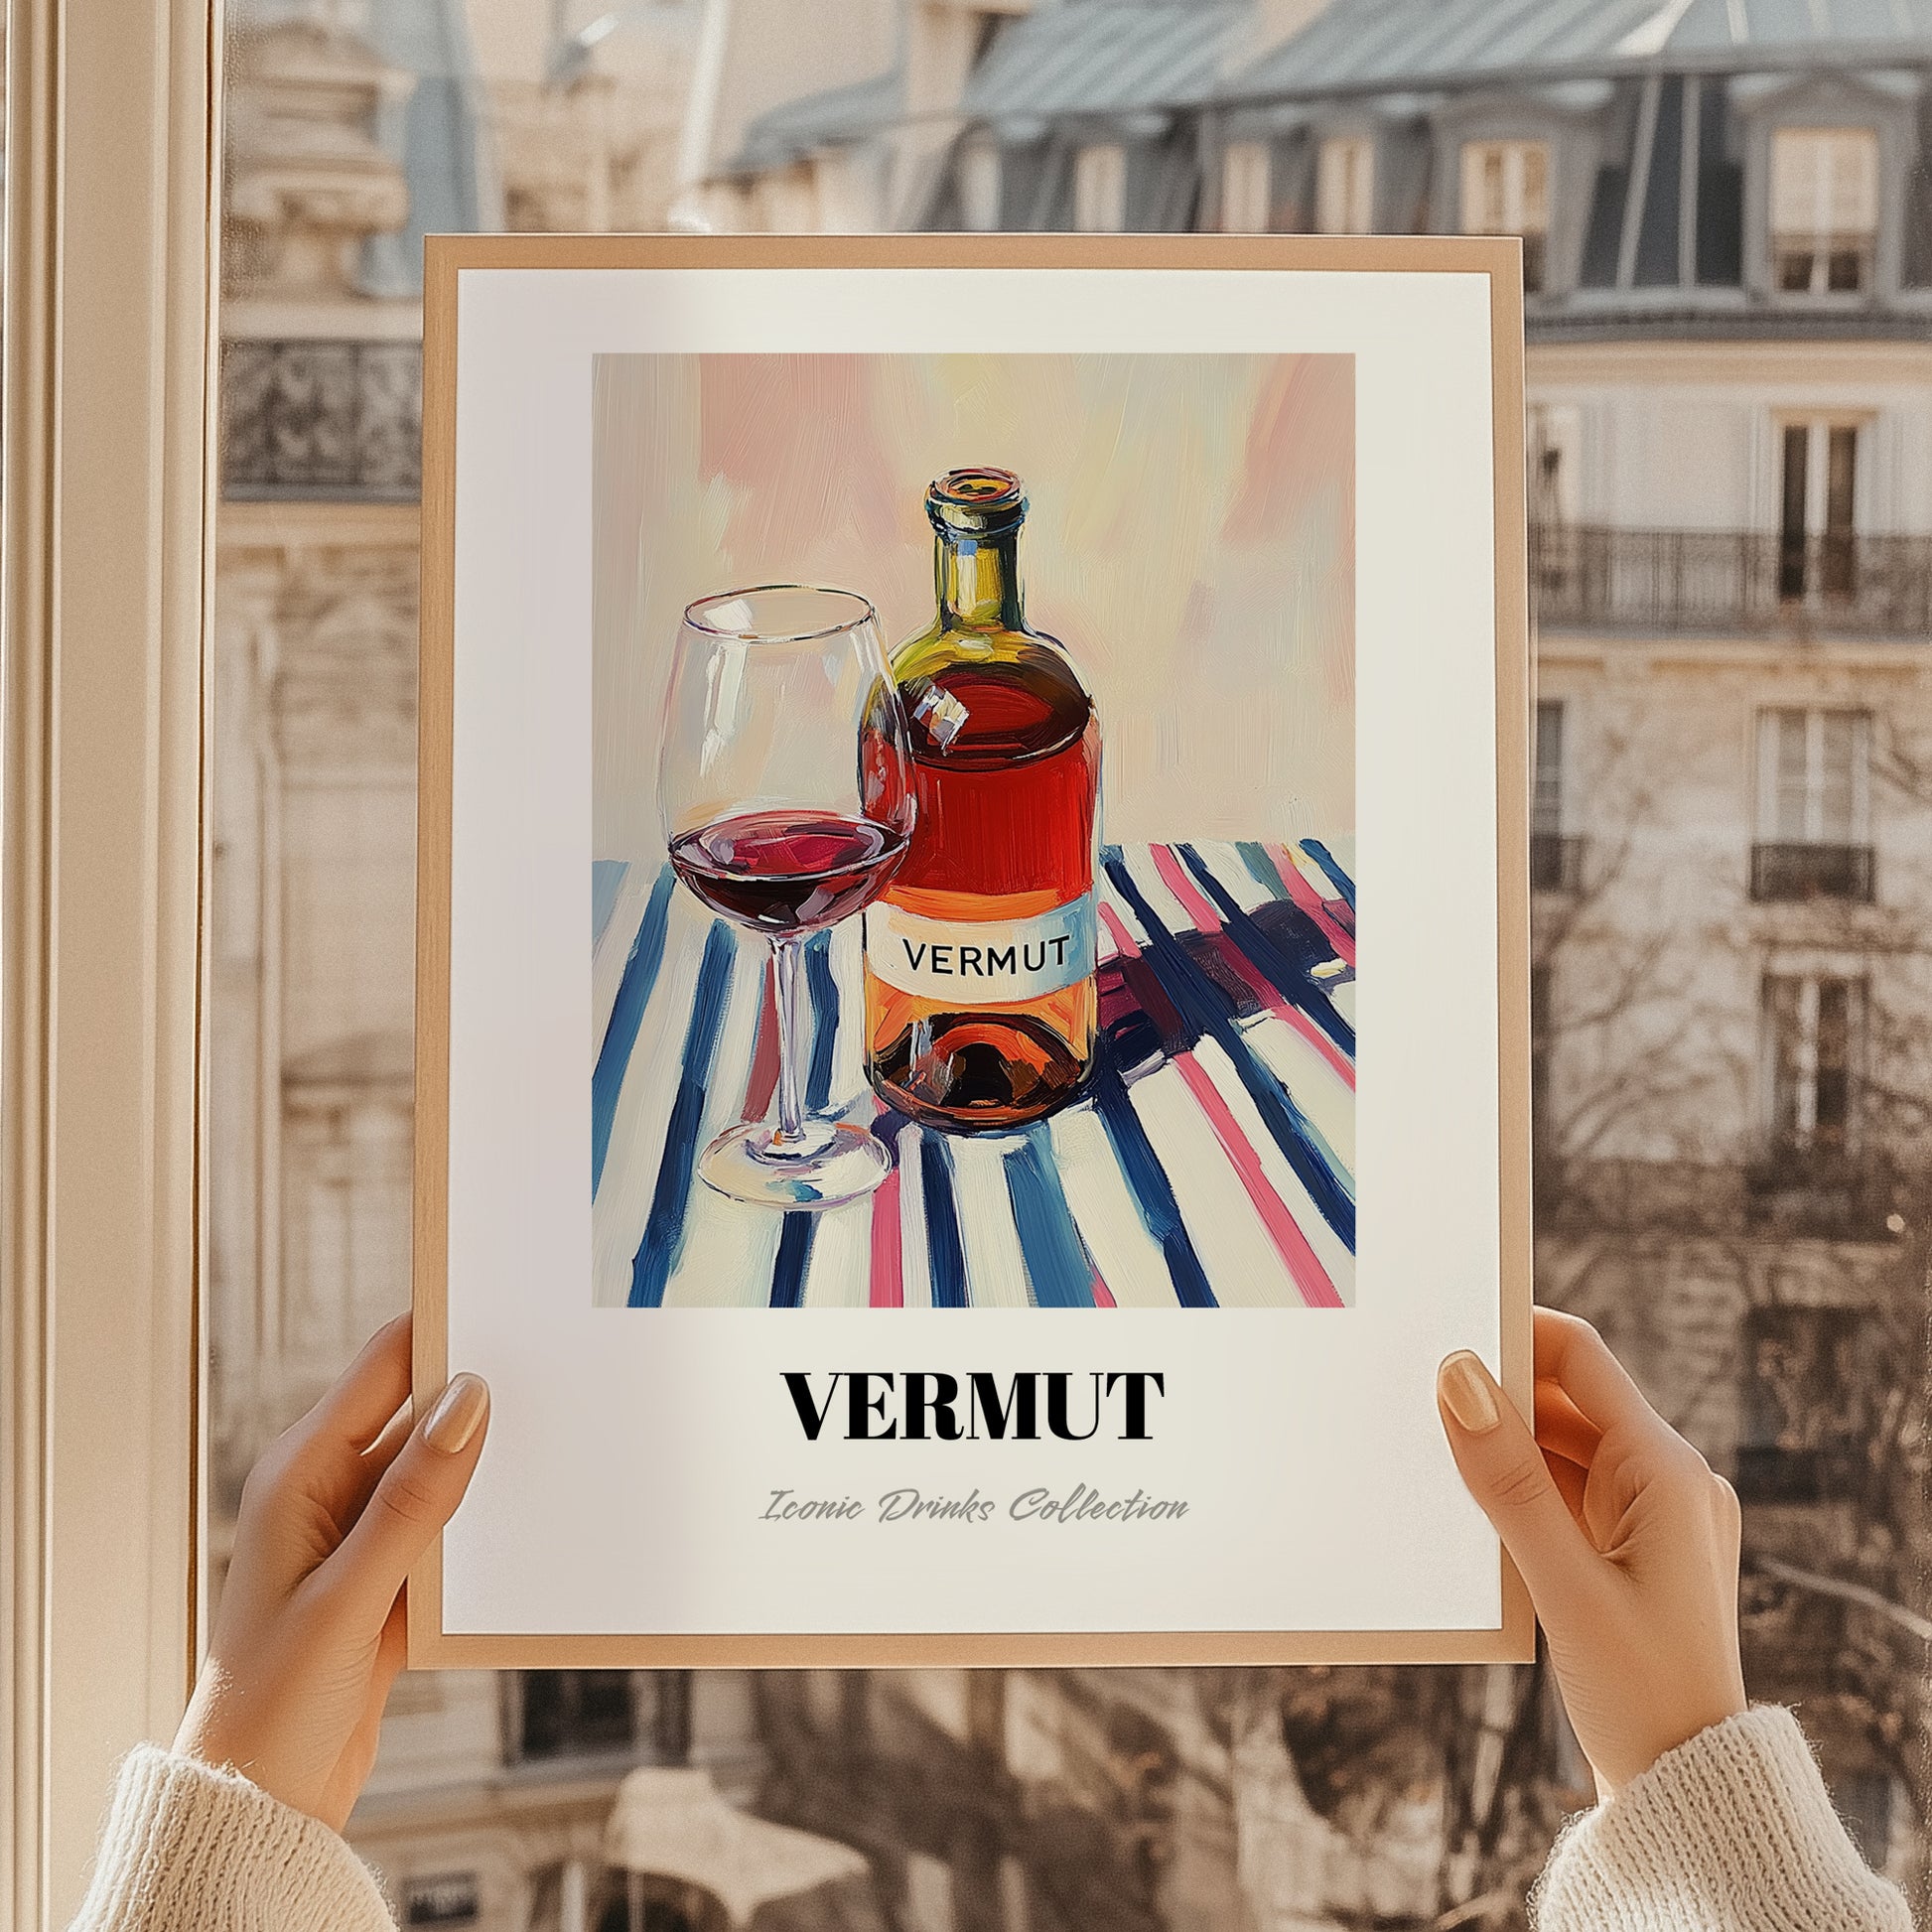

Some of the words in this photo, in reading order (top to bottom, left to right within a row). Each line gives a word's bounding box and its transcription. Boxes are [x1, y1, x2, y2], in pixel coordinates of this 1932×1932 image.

[902, 935, 1070, 977] VERMUT
[779, 1373, 1165, 1441] VERMUT
[759, 1488, 866, 1522] Iconic
[878, 1488, 996, 1524] Drinks
[1009, 1482, 1190, 1524] Collection
